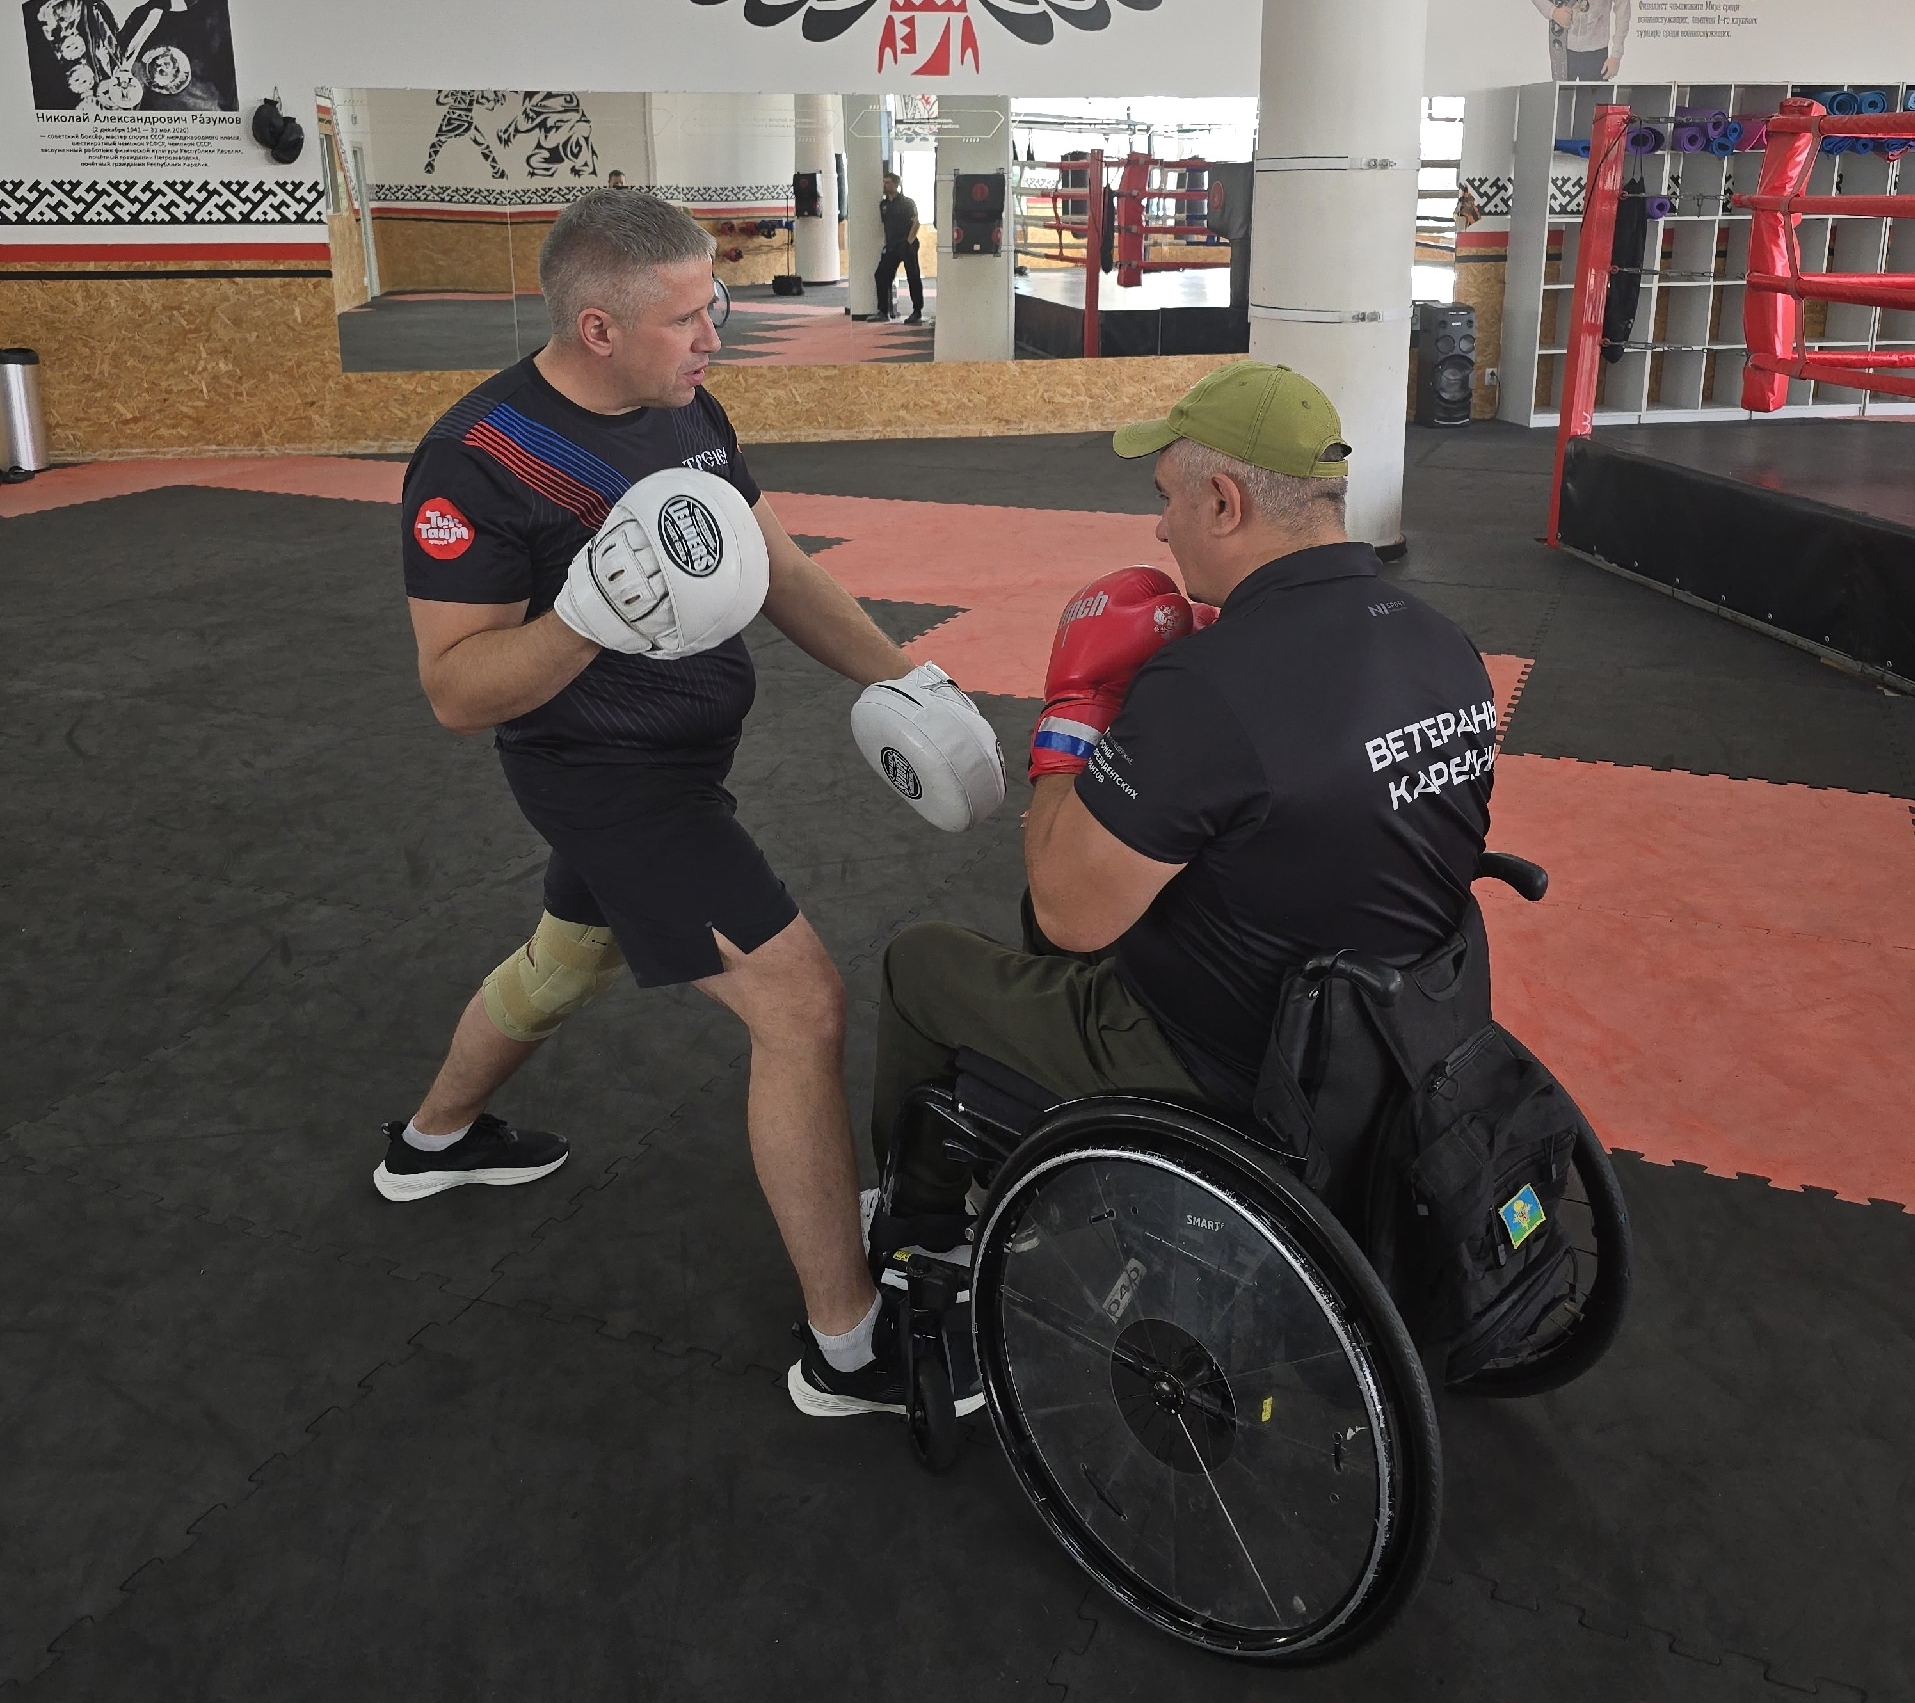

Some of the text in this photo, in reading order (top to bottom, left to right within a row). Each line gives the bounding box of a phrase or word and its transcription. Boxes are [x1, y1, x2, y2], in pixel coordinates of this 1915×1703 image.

[36, 112, 90, 123] Николай
[94, 113, 188, 126] Александрович
[667, 500, 714, 571] LEADERS
